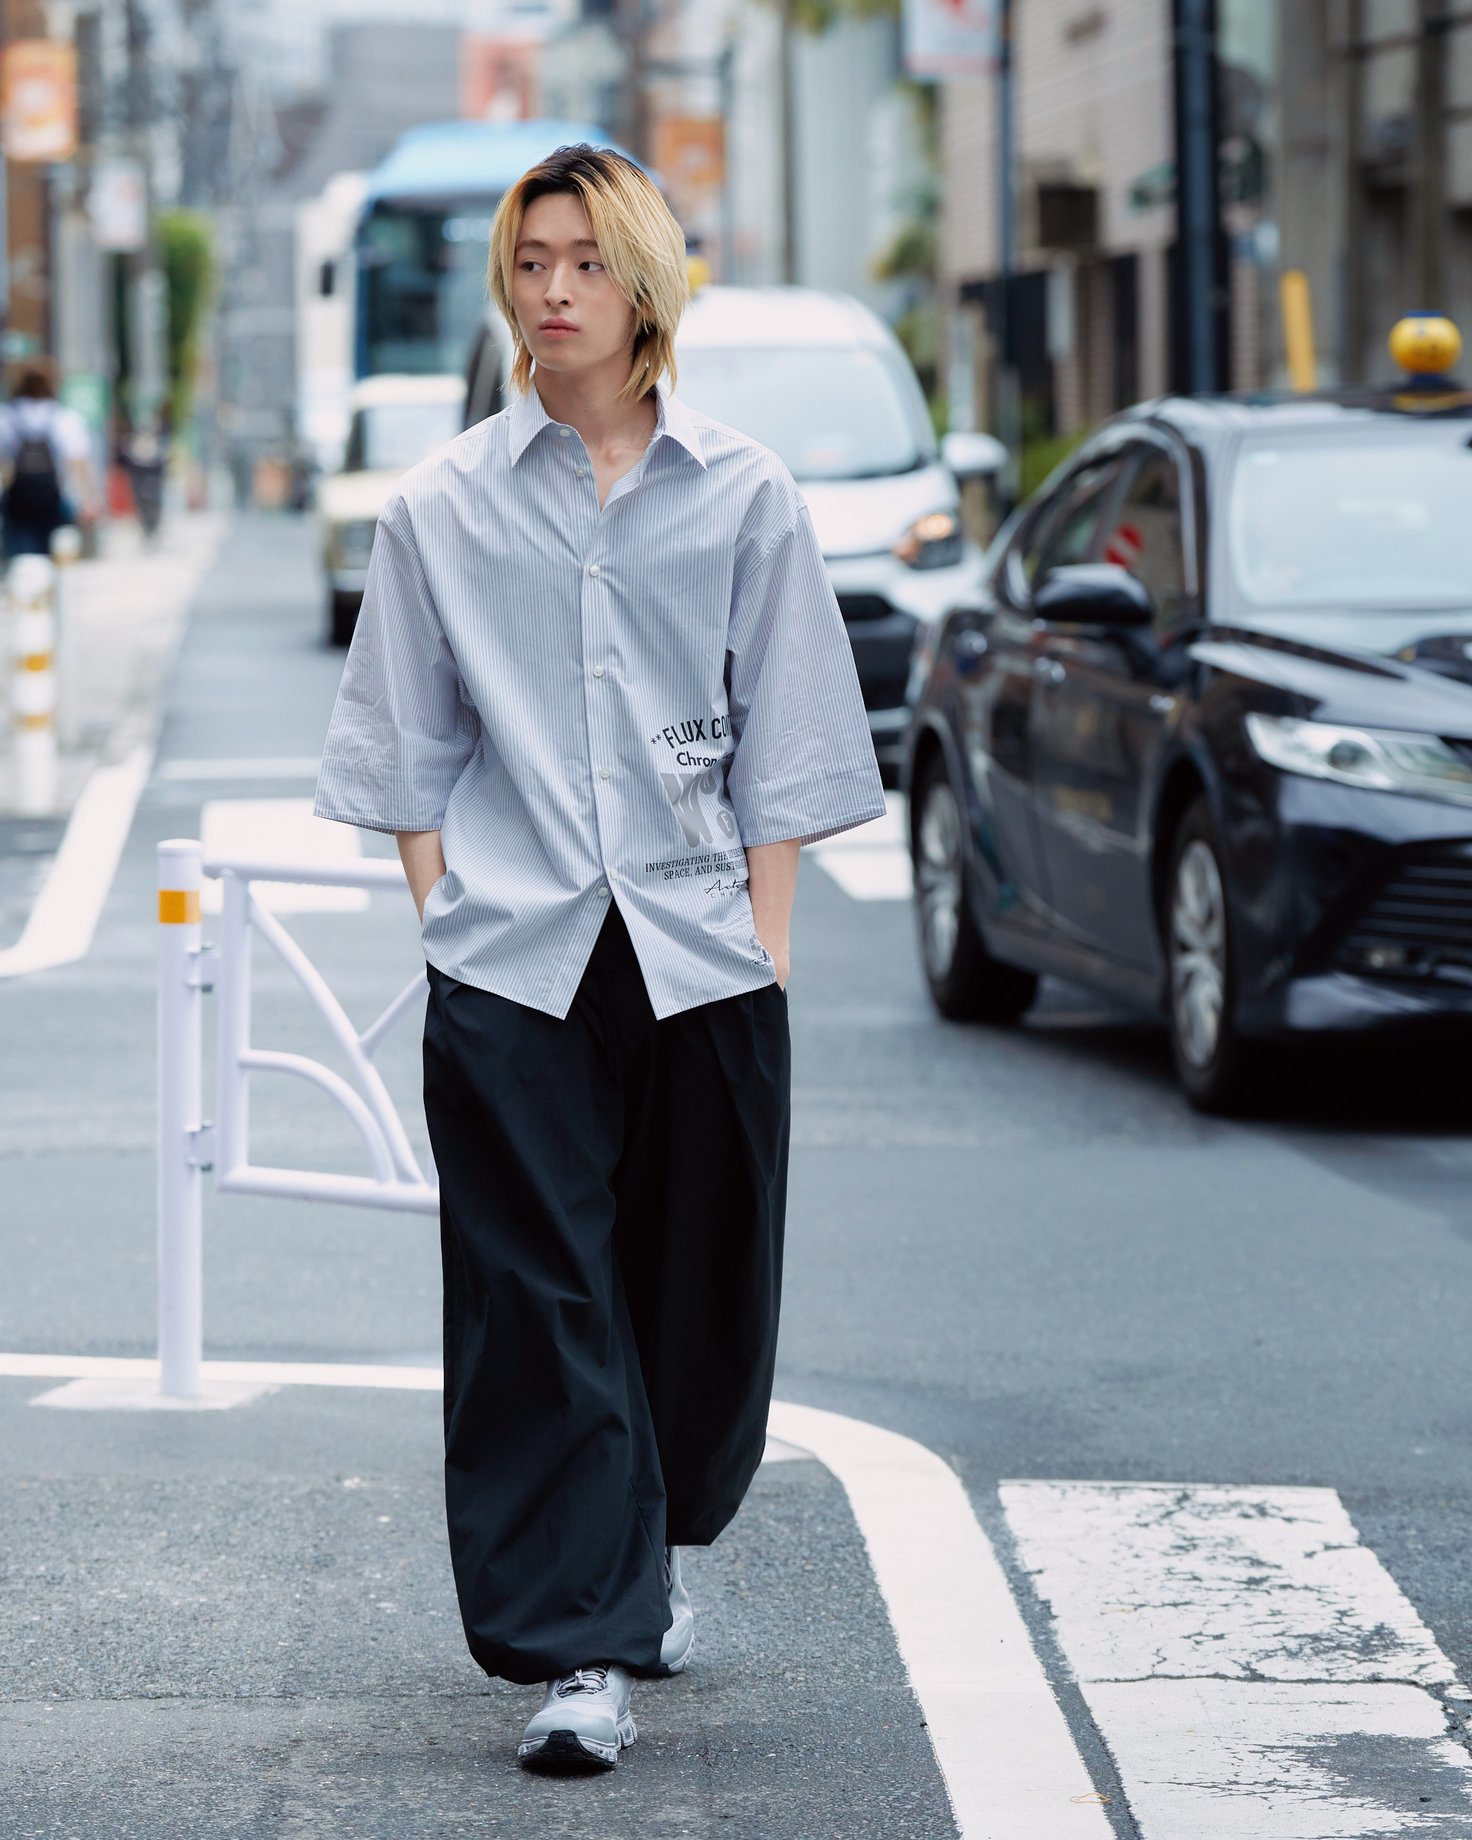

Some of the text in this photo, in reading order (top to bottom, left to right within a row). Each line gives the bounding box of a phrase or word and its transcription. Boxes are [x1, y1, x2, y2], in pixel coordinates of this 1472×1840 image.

[645, 854, 710, 873] INVESTIGATING
[712, 851, 729, 862] THE
[694, 864, 713, 876] AND
